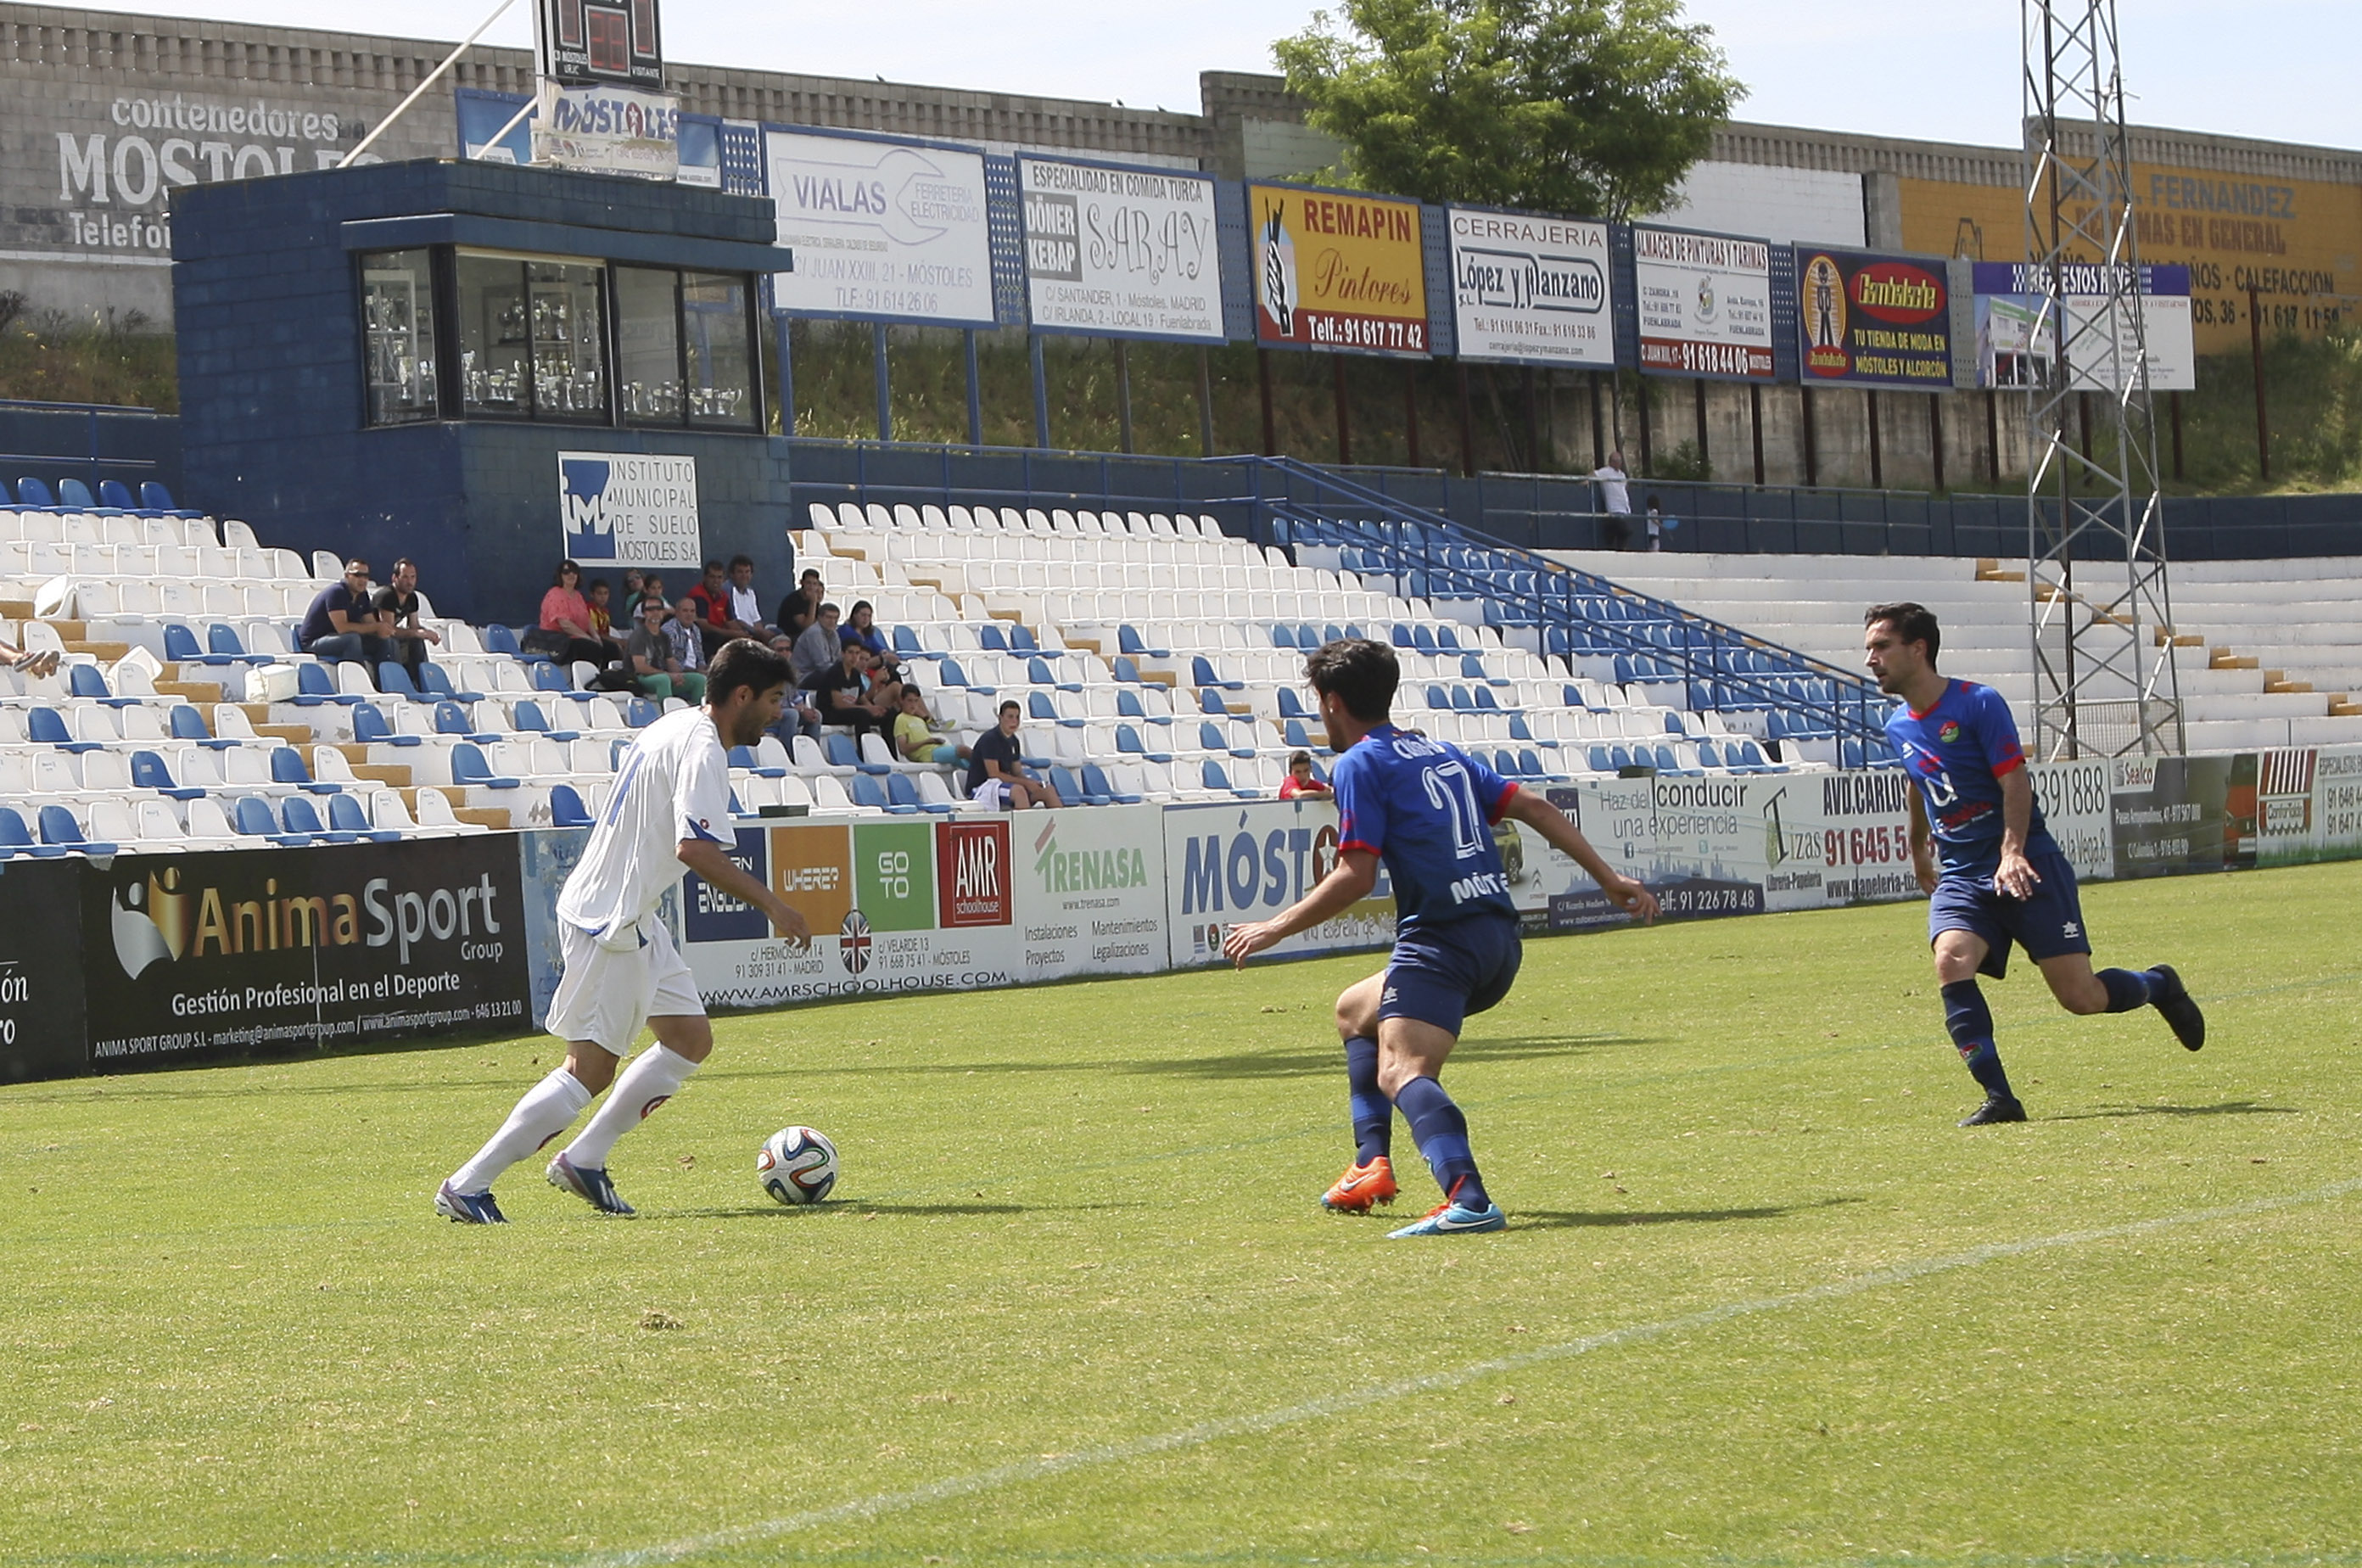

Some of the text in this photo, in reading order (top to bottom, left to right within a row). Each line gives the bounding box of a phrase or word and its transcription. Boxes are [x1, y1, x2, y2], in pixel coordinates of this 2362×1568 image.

[113, 93, 339, 141] contenedores
[55, 132, 384, 205] MOST
[1033, 165, 1203, 203] ESPECIALIDAD EN COMIDA TURCA
[793, 175, 887, 215] VIALAS
[915, 182, 973, 204] FERRETERIA
[2152, 174, 2296, 219] FERNANDEZ
[911, 201, 979, 222] ELECTRICIDAD
[1026, 194, 1076, 236] DÖNER
[1304, 199, 1411, 243] REMAPIN
[69, 211, 170, 249] Telefo
[1087, 203, 1211, 286] SARAY
[1453, 216, 1603, 248] CERRAJERIA
[2180, 214, 2203, 248] EN
[2209, 219, 2286, 255] GENERAL
[1028, 238, 1076, 272] KEBAP
[810, 257, 845, 279] JUAN
[882, 263, 895, 283] 21
[908, 260, 973, 288] MÓSTOLES
[1315, 248, 1412, 305] Pintores
[2235, 265, 2333, 296] CALEFACCION
[866, 289, 879, 309] 91
[883, 290, 904, 311] 614
[908, 293, 921, 311] 26
[1171, 296, 1206, 312] MADRID
[1510, 268, 1520, 309] y
[1111, 311, 1141, 327] LOCAL
[1160, 314, 1212, 331] Fuenlabrada
[2220, 300, 2235, 324] 36
[1307, 315, 1423, 349] Telf.: 91 617 77 42
[1854, 329, 1945, 352] TU TIENDA DE MODA EN
[1682, 342, 1696, 370] 91
[1699, 344, 1718, 372] 618
[1720, 346, 1733, 373] 44
[1735, 347, 1748, 375] 06
[612, 461, 693, 482] INSTITUTO
[613, 487, 695, 508] MUNICIPAL
[615, 514, 697, 535] DE SUELO
[1601, 778, 1749, 811] Haz del conducir
[1614, 809, 1738, 841] una experiencia
[1825, 829, 1846, 867] 91
[1850, 826, 1890, 865] 645
[783, 866, 839, 891] WHERE?
[878, 851, 910, 875] GO
[956, 836, 998, 898] AMR
[1034, 836, 1147, 893] TRENASA
[879, 876, 910, 899] TO
[1062, 896, 1120, 910] www.trenasa.com
[1656, 888, 1755, 911] elf: 91 226 78 48
[193, 872, 501, 965] AnimaSport
[956, 899, 999, 915] schoolhouse
[1025, 917, 1158, 941] Instalaciones Mantenimientos
[462, 940, 503, 963] Group
[887, 938, 918, 953] VELARDE
[920, 937, 929, 951] 13
[1026, 942, 1149, 968] Proyectos Legalizaciones
[736, 964, 745, 978] 91
[765, 962, 774, 977] 31
[777, 961, 786, 976] 41
[793, 960, 824, 975] MADRID
[878, 955, 887, 970] 91
[917, 954, 926, 967] 41
[171, 972, 461, 1016] Gestión Profesional en el Deporte
[697, 971, 1006, 1002] WWW.AMRSCHOOLHOUSE.COM
[129, 1035, 158, 1055] SPORT
[159, 1032, 193, 1051] GROUP
[491, 1003, 501, 1017] 13
[502, 1002, 511, 1016] 21
